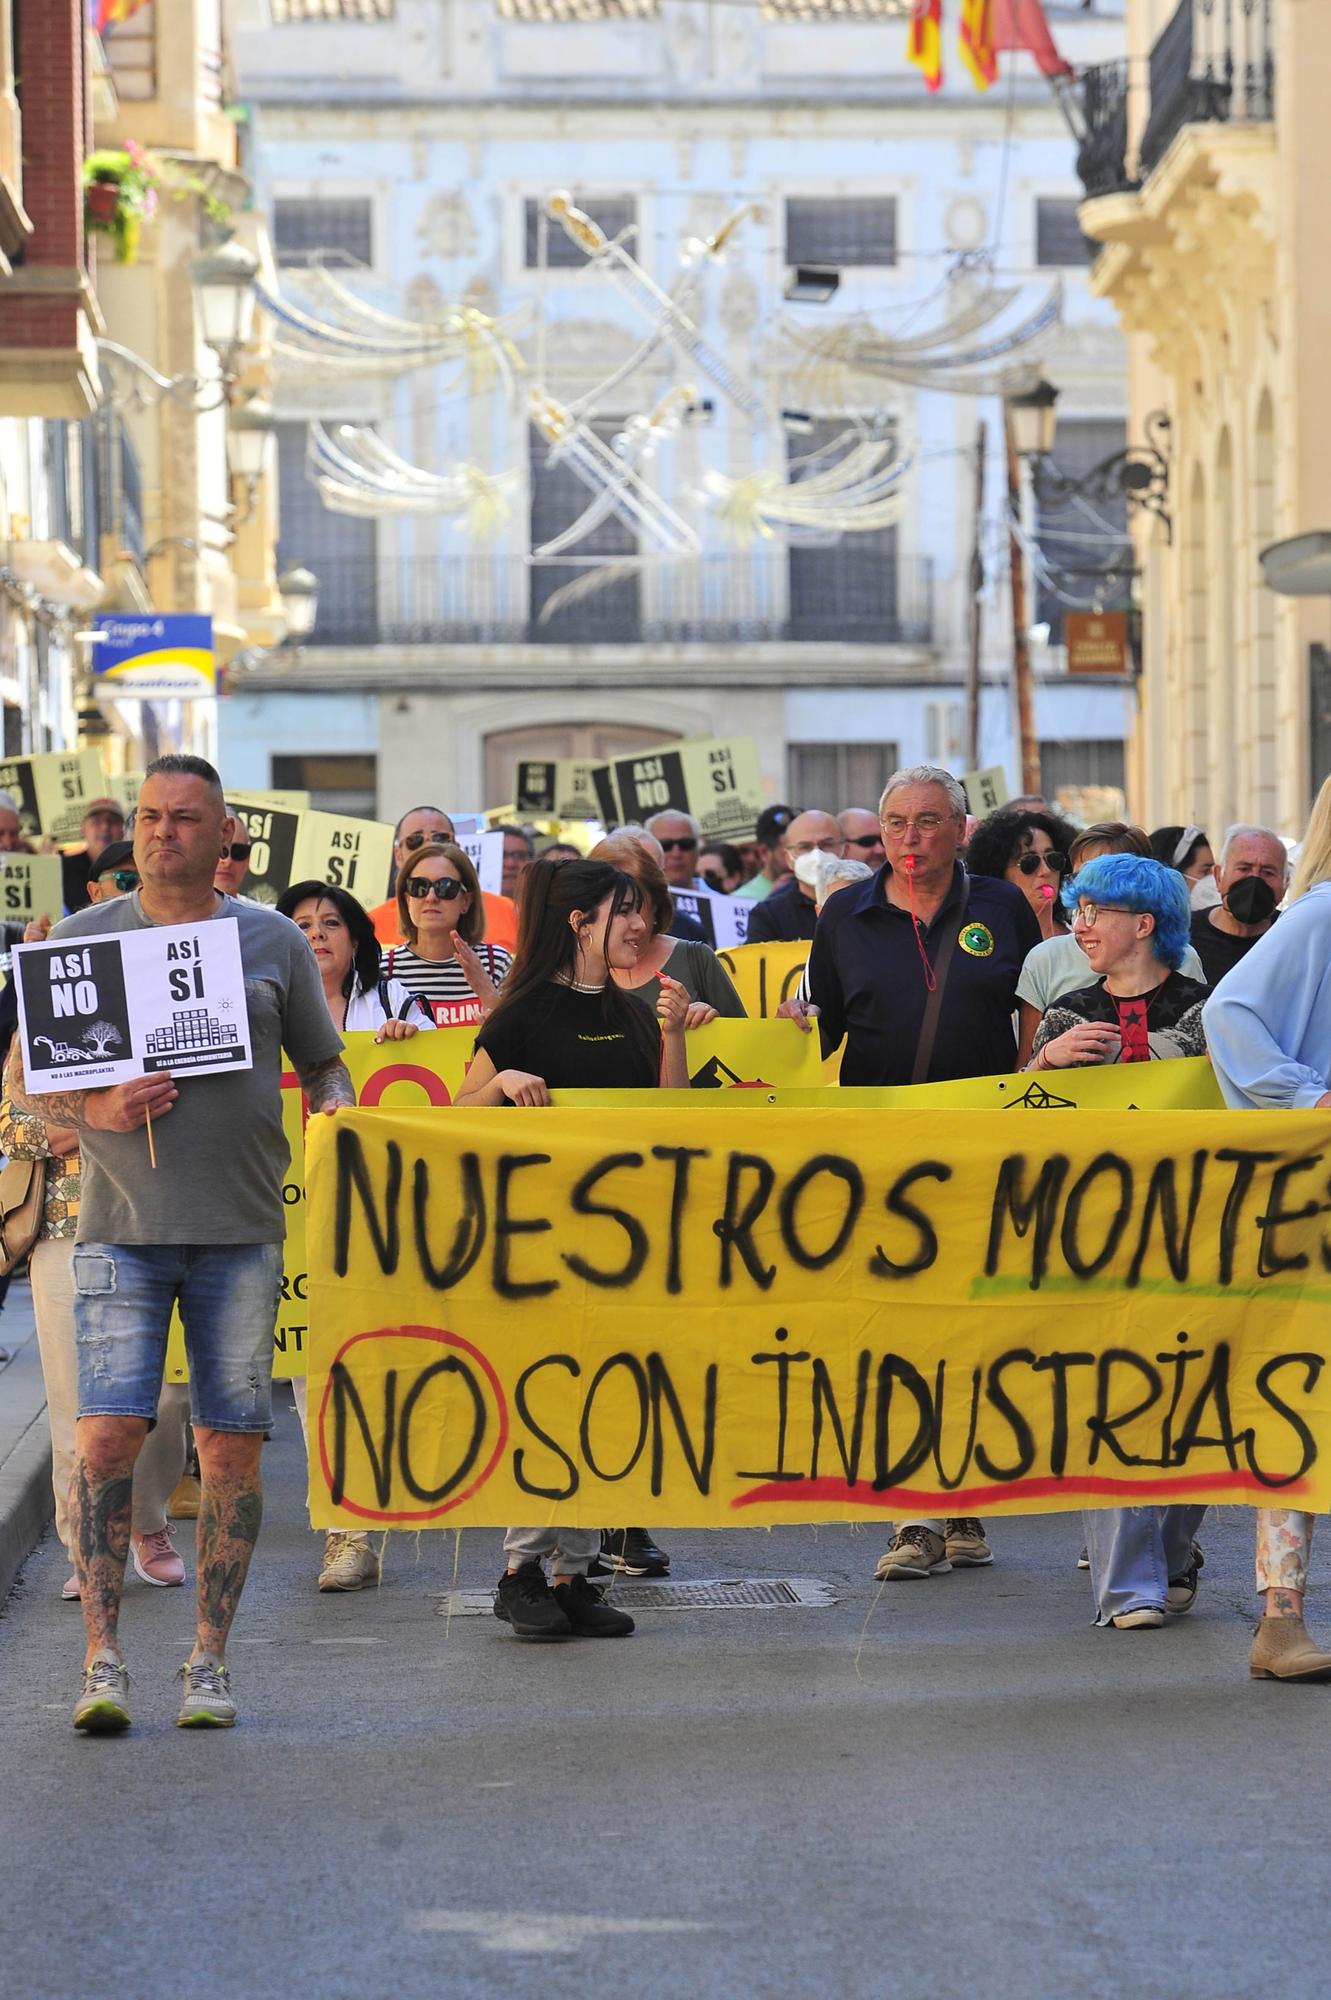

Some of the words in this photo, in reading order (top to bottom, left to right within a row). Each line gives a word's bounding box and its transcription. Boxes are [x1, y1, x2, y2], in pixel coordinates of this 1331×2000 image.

[633, 756, 664, 781] ASÍ
[712, 763, 736, 793] SÍ
[635, 779, 670, 809] NO
[331, 831, 362, 851] ASÍ
[5, 863, 31, 880] ASÍ
[249, 841, 271, 876] O
[326, 854, 360, 889] SÍ
[5, 880, 33, 909] SÍ
[167, 936, 200, 961] ASÍ
[49, 948, 92, 980] ASÍ
[168, 960, 205, 1002] SÍ
[51, 980, 99, 1018] NO
[431, 1003, 480, 1025] RLIN
[333, 1126, 953, 1299] NUESTROS
[331, 1354, 487, 1508] NO
[512, 1351, 718, 1501] SON
